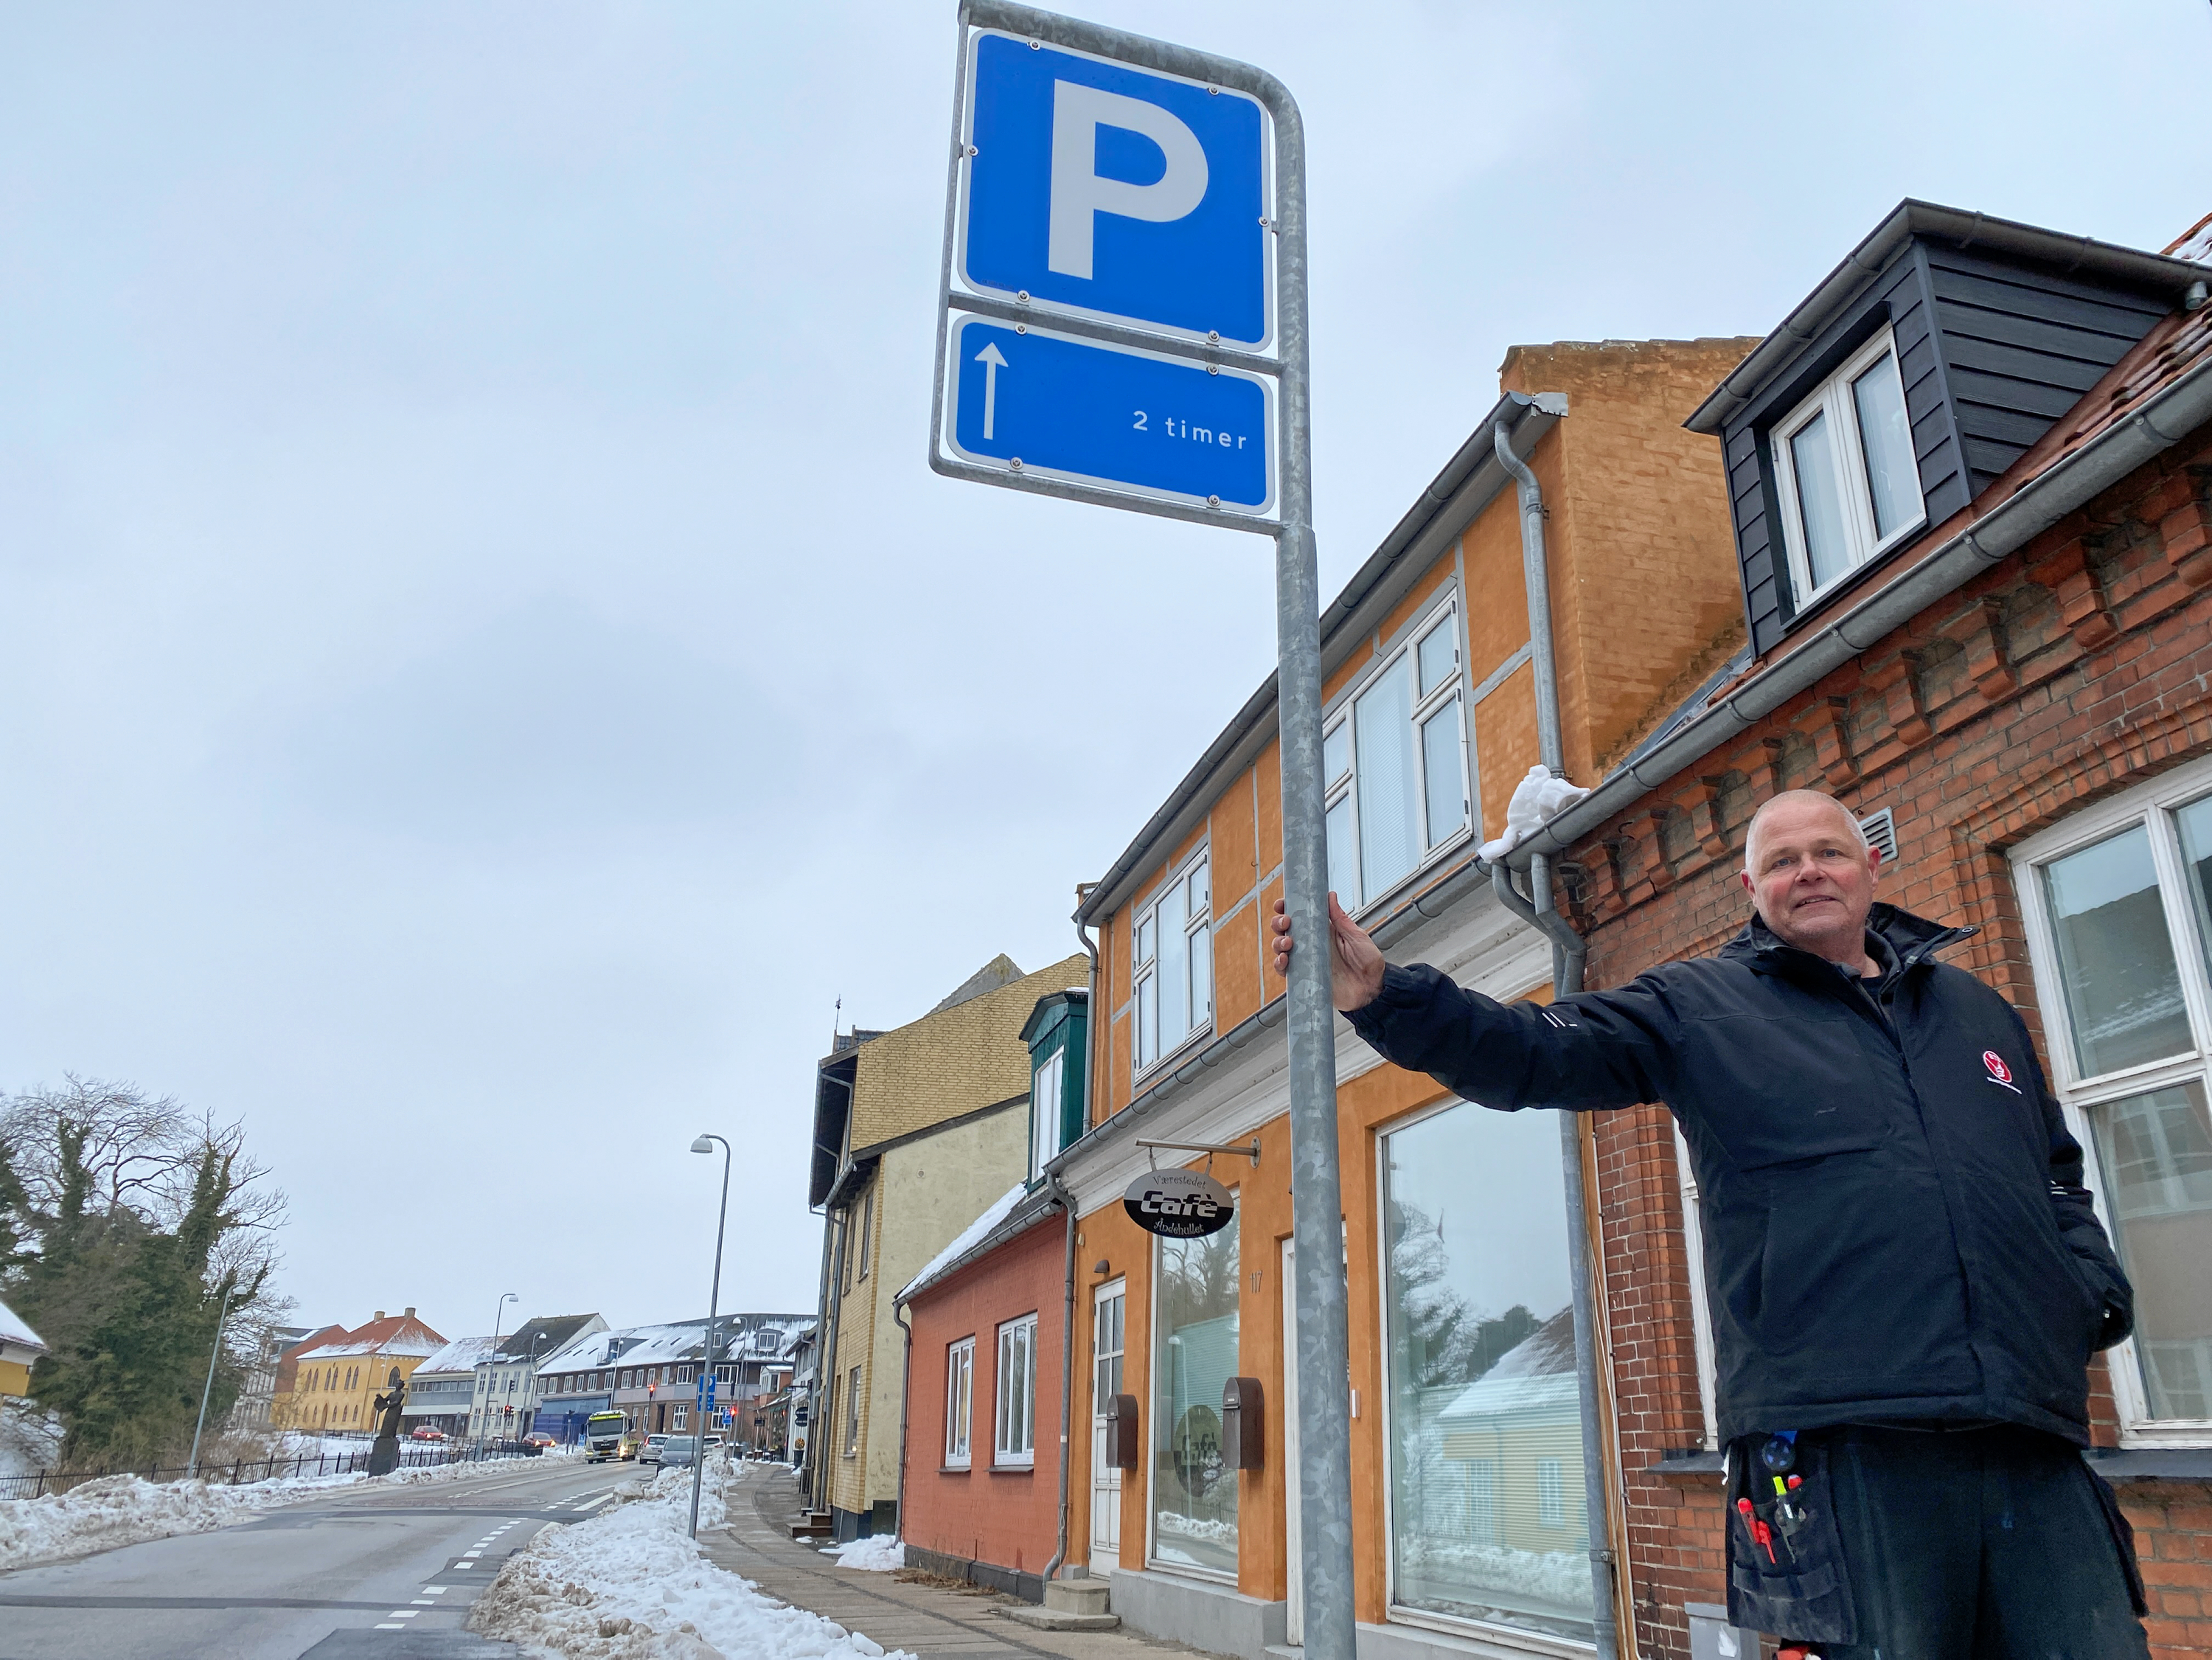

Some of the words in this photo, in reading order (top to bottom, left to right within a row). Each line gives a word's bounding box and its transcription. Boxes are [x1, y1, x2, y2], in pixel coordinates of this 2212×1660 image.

[1048, 79, 1208, 280] P
[1133, 410, 1148, 431] 2
[1166, 417, 1247, 450] timer
[1153, 1175, 1207, 1189] Værestedet
[1154, 1218, 1204, 1235] Åndehullet
